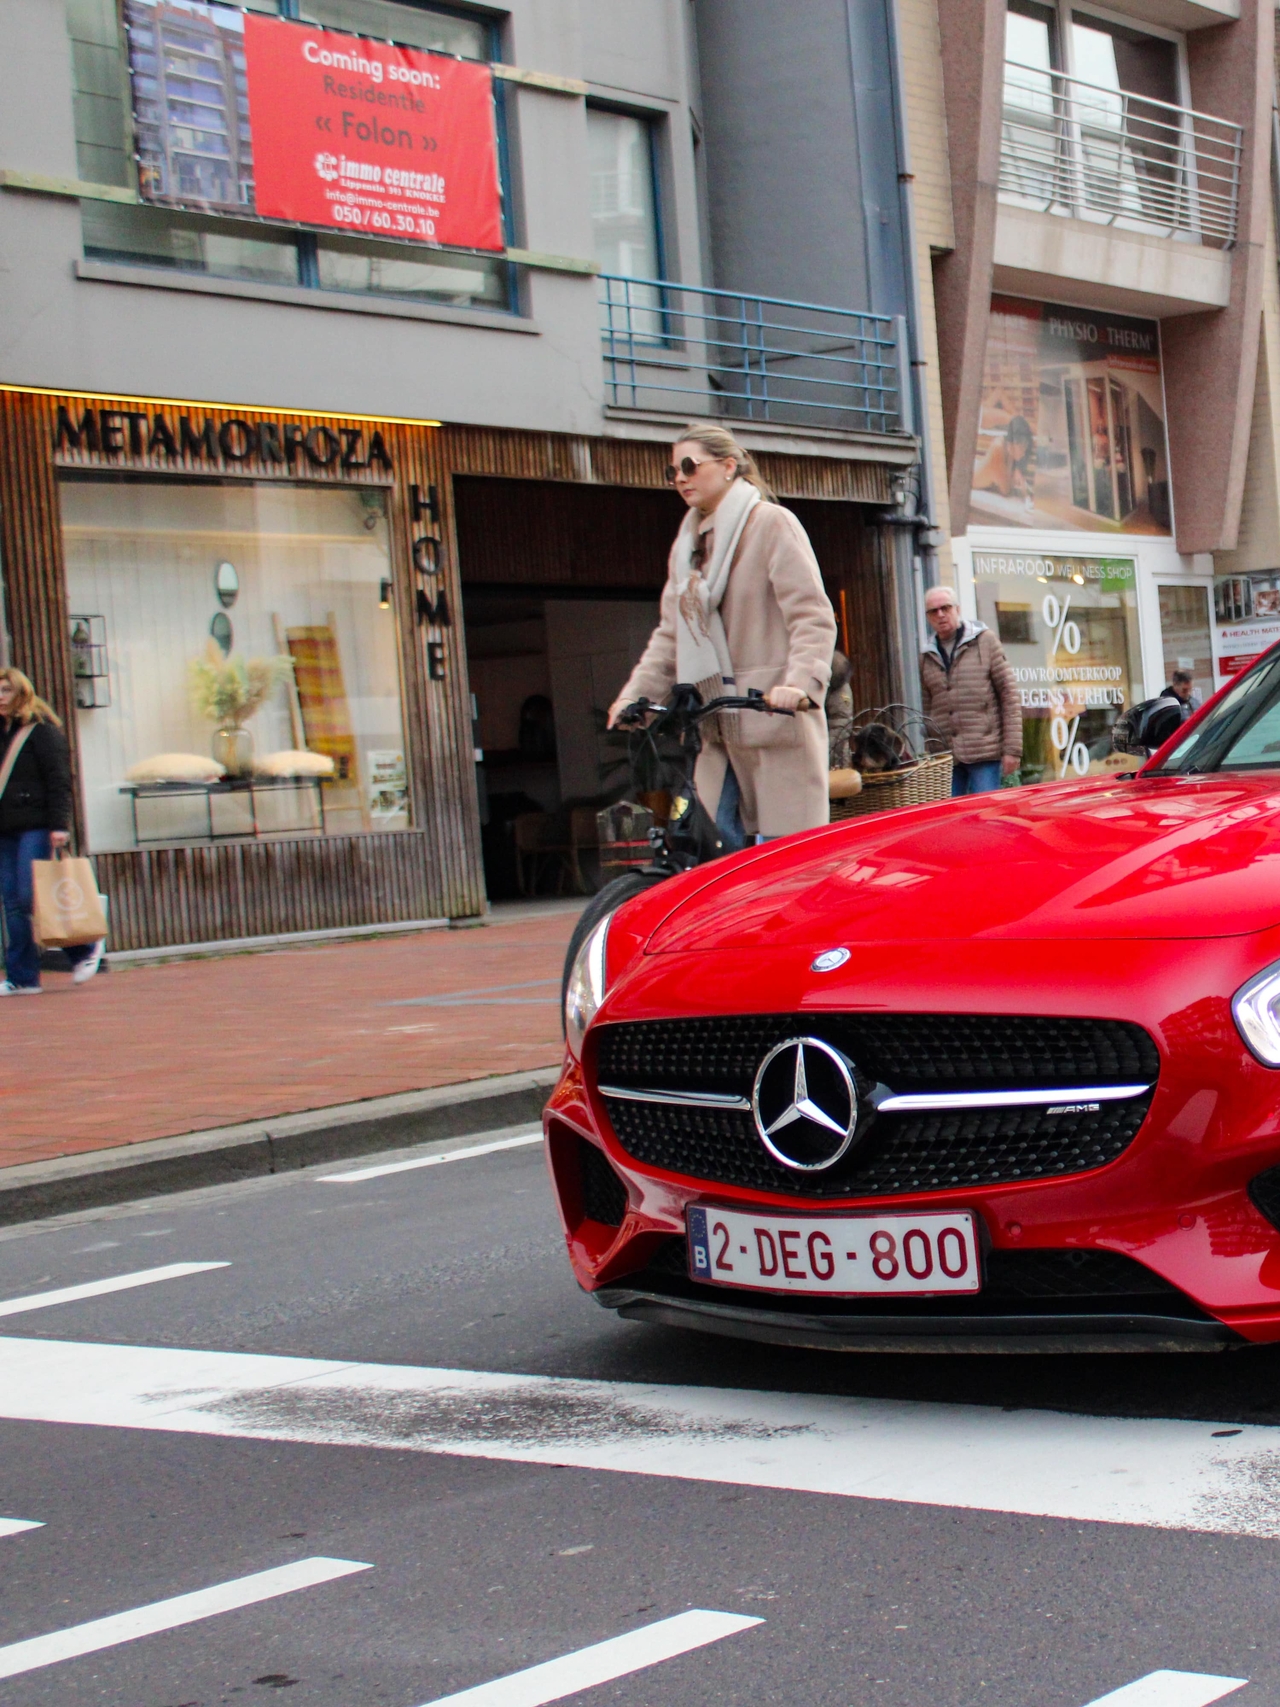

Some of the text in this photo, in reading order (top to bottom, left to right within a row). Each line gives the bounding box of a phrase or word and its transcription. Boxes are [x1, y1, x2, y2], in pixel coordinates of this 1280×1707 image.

[303, 40, 441, 89] Coming soon:
[323, 75, 425, 113] Residentie
[341, 111, 413, 149] Folon
[340, 155, 445, 194] immo centrale
[326, 188, 440, 217] info@immo-centrale.be
[405, 188, 446, 203] KNOKKE
[1050, 317, 1098, 344] PHYSIO
[55, 404, 394, 471] METAMORFOZA
[410, 483, 452, 682] HOME
[976, 557, 1133, 580] INFRAROOD WELLNESS SHOP
[1229, 626, 1280, 638] HEALTH MATE
[1012, 666, 1122, 683] HOWROOMVERKOOP
[1067, 687, 1125, 705] VERHUIS
[1061, 1103, 1100, 1114] AMG
[694, 1221, 969, 1281] B 2-DEG-800
